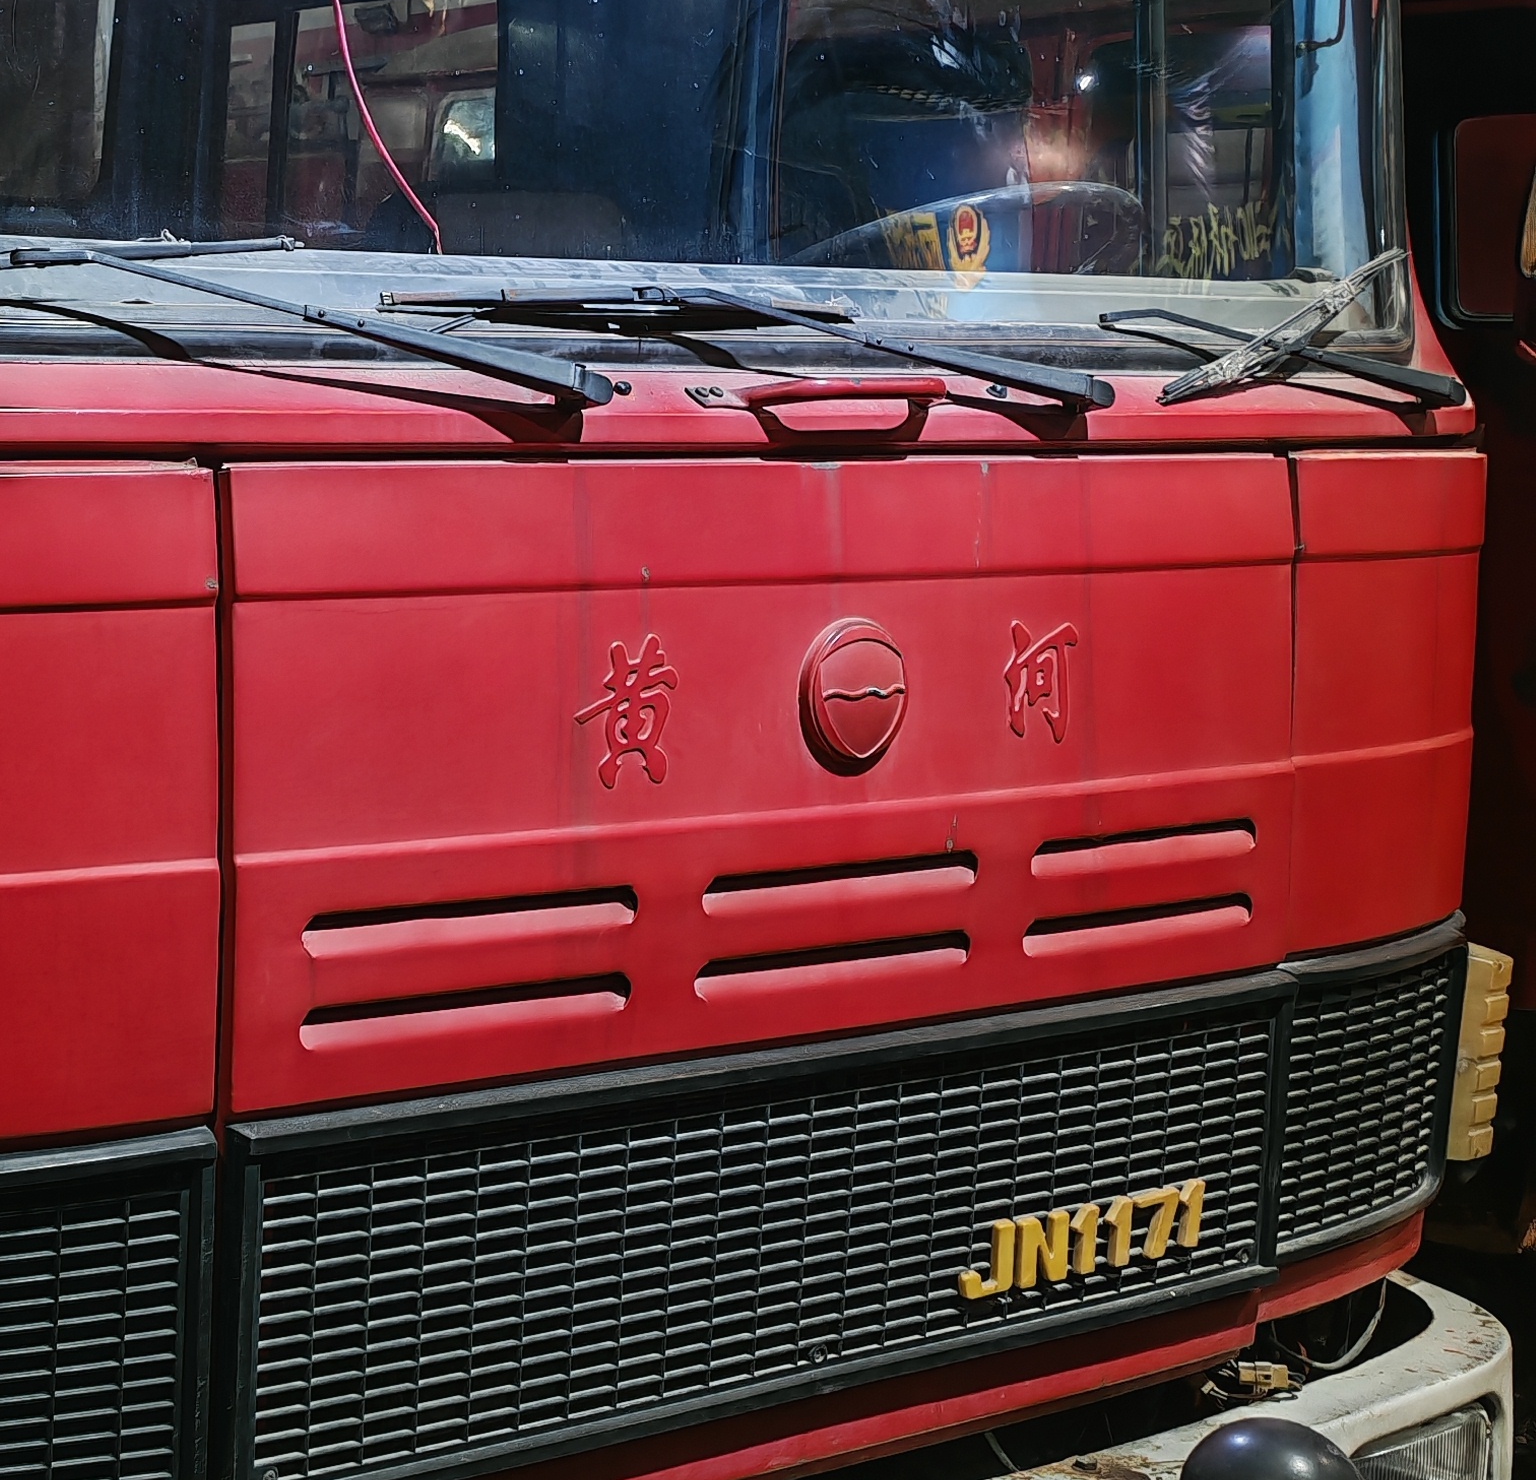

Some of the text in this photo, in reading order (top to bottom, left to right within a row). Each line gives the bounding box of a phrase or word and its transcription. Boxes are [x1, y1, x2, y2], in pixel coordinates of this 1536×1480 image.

[573, 619, 1079, 790] 黄 河
[957, 1177, 1207, 1301] JN1171
